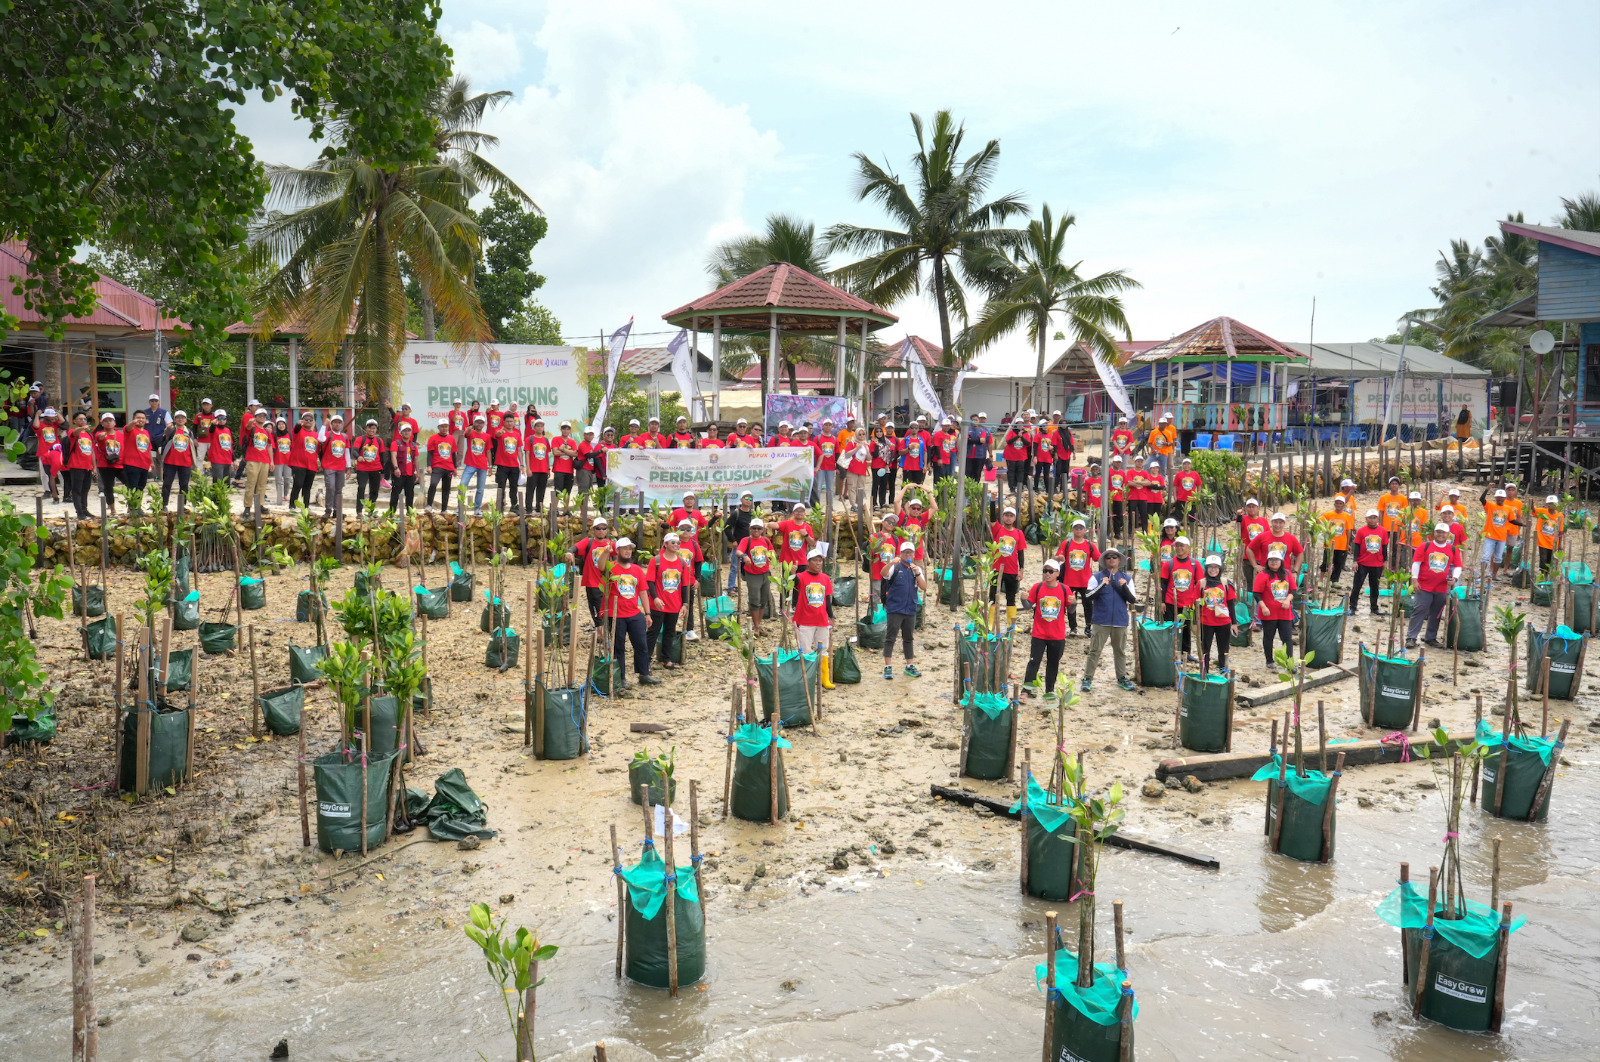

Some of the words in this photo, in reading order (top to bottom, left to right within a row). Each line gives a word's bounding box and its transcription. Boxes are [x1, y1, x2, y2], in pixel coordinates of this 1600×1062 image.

[428, 386, 492, 406] PERISAI
[496, 386, 558, 406] GUSUNG
[1368, 393, 1415, 402] PERSAI
[1418, 392, 1472, 402] GUUNG
[650, 471, 708, 482] PERISAI
